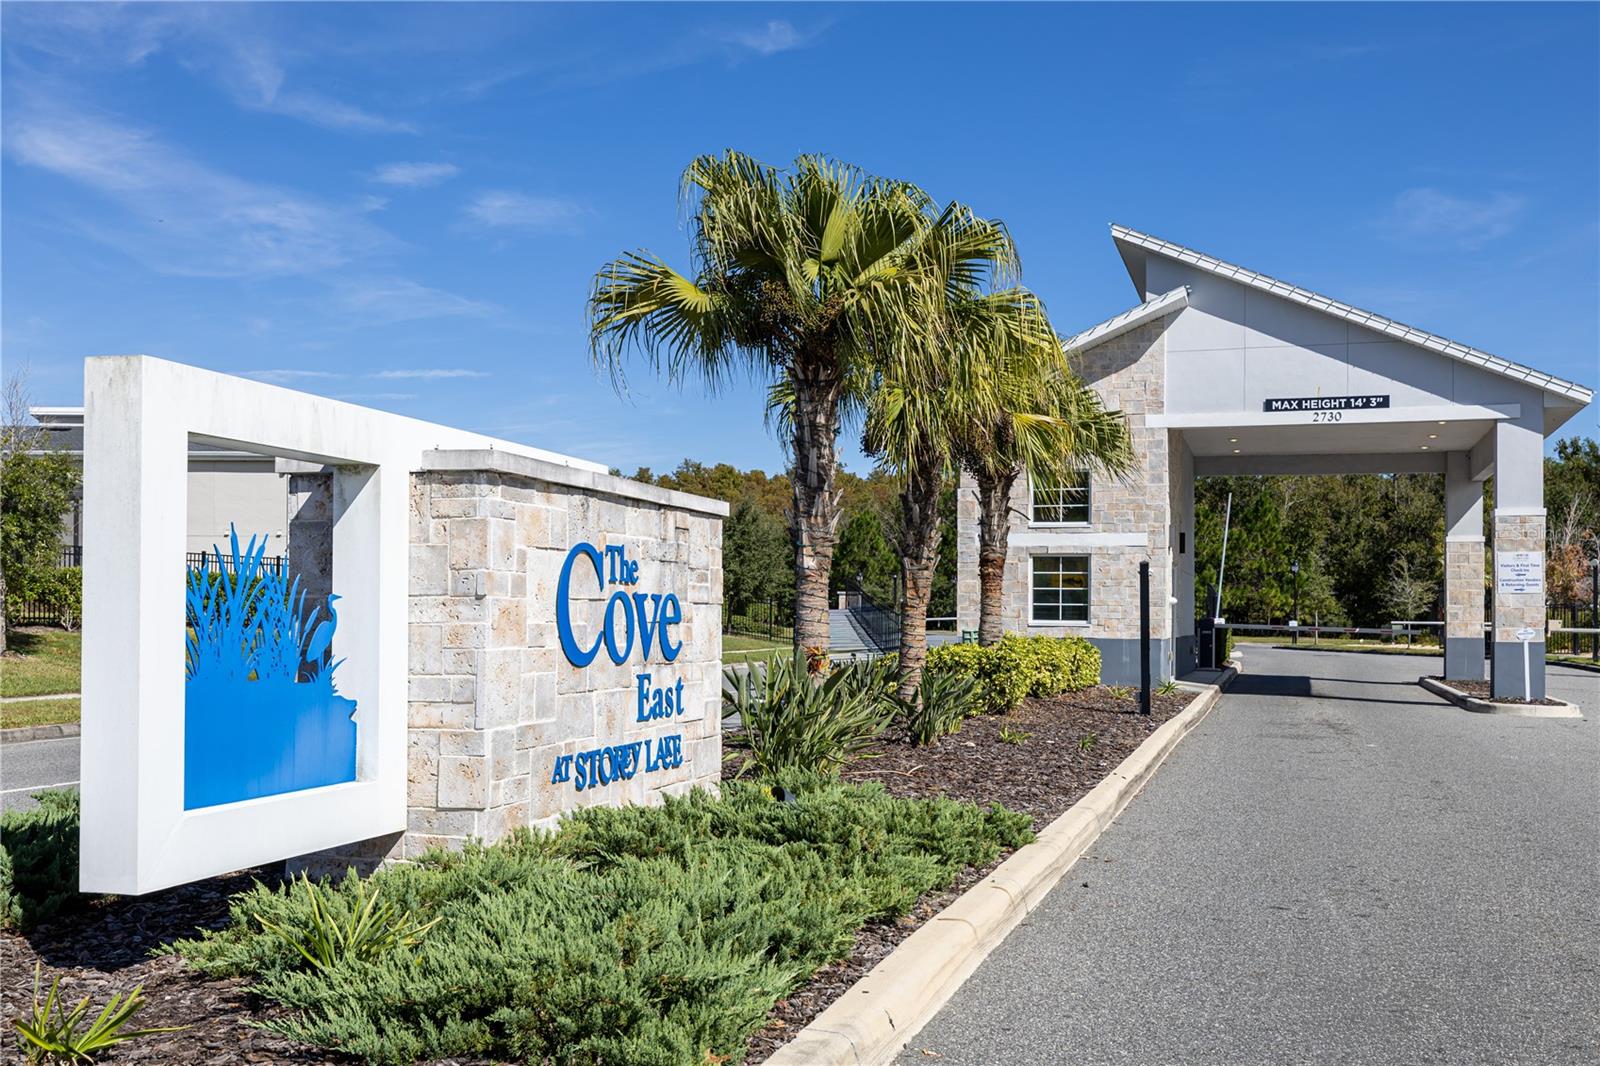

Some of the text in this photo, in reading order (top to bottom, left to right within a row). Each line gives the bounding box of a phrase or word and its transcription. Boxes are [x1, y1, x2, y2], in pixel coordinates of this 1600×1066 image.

[1272, 400, 1299, 410] MAX
[1302, 399, 1348, 409] HEIGHT
[1313, 411, 1342, 422] 2730
[605, 544, 639, 586] The
[556, 542, 683, 668] Cove
[636, 672, 684, 722] East
[551, 734, 683, 792] AT STOREY LAKE
